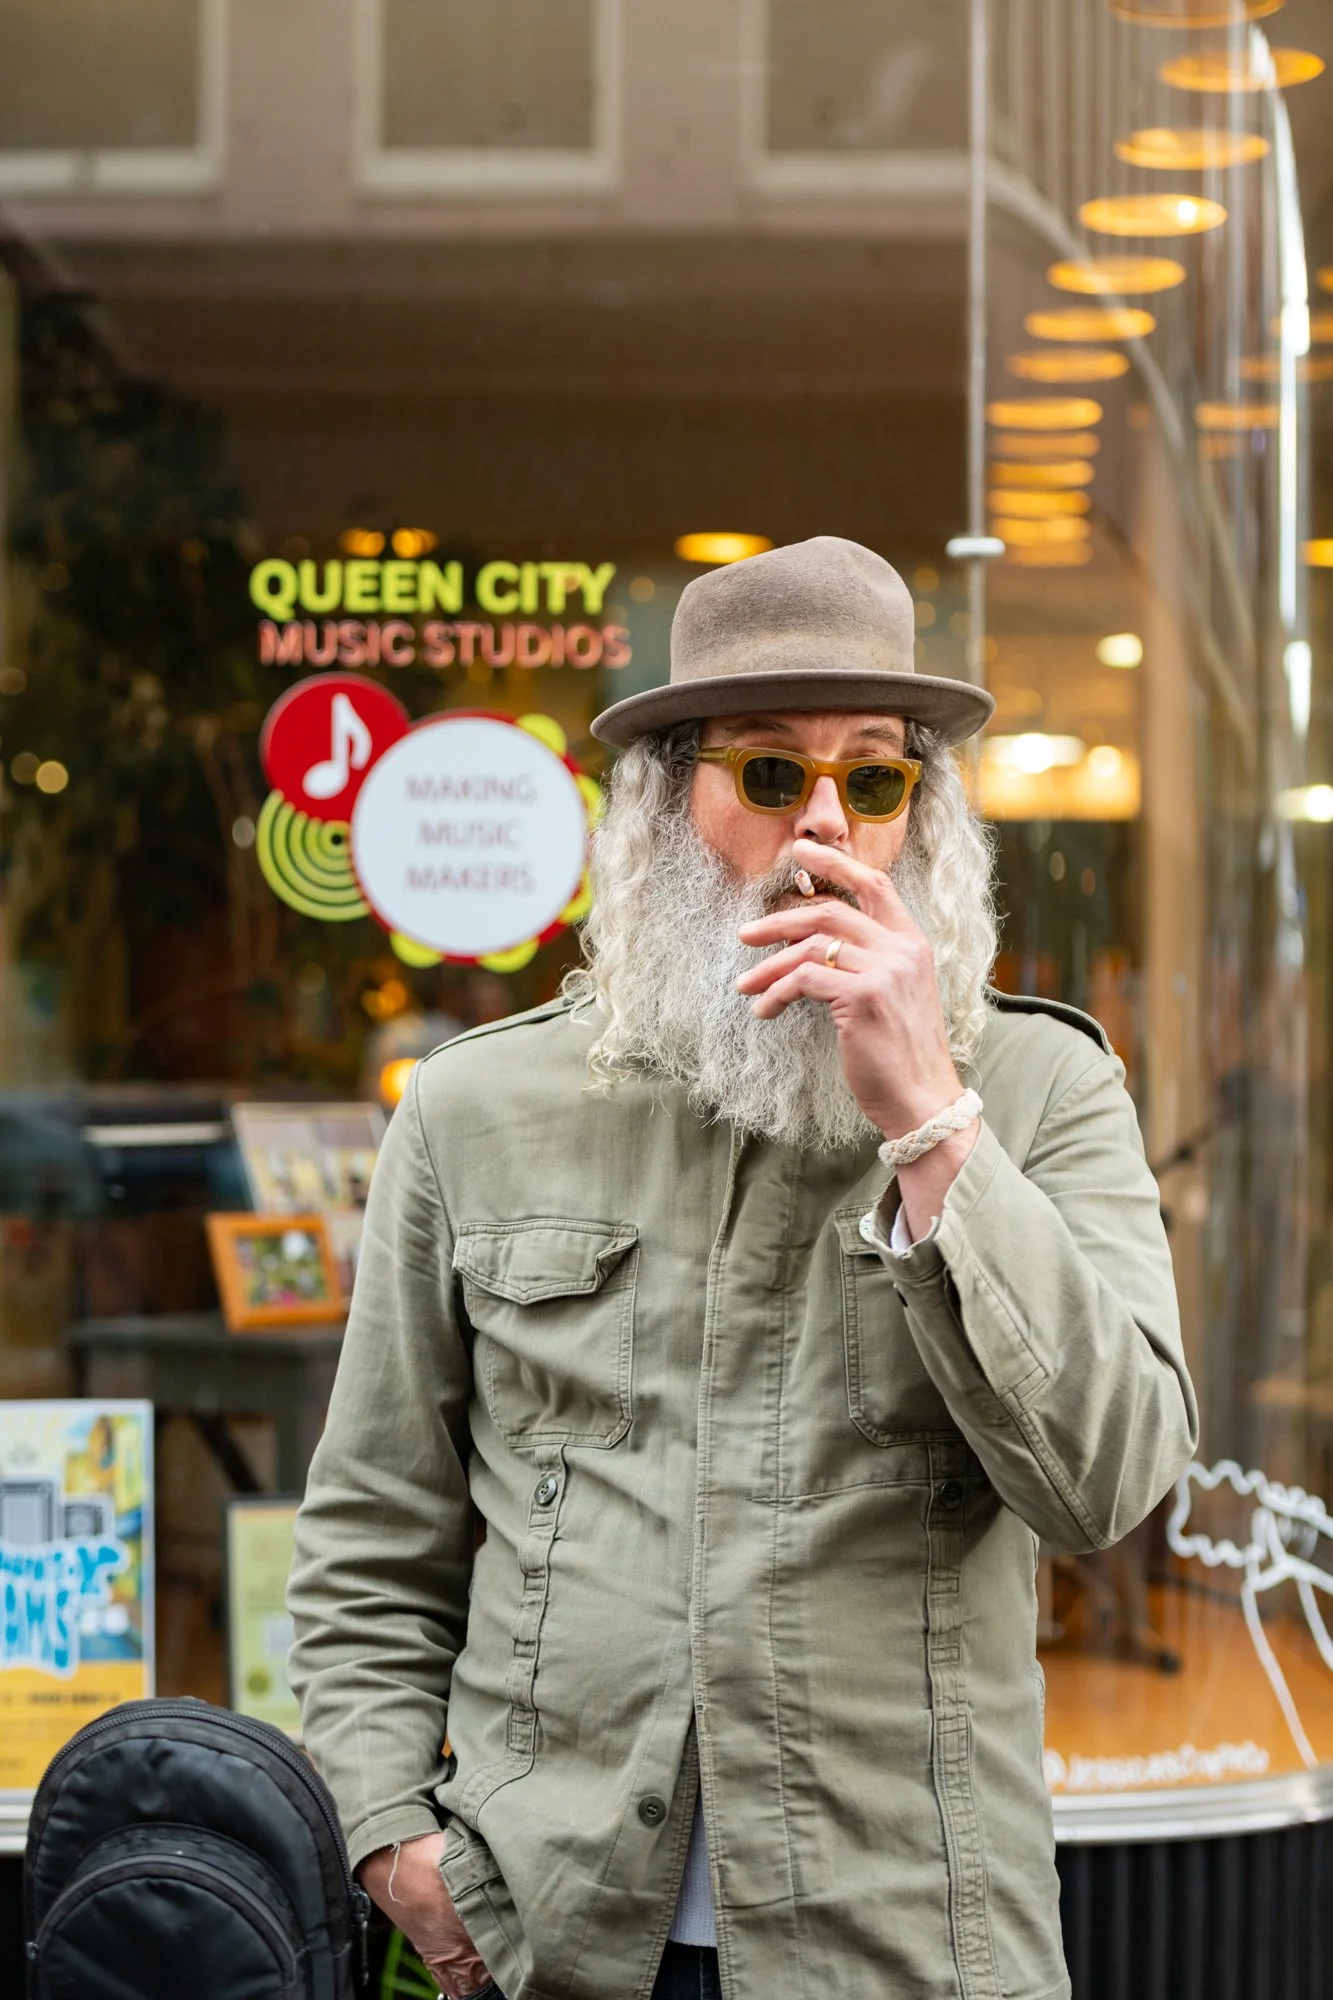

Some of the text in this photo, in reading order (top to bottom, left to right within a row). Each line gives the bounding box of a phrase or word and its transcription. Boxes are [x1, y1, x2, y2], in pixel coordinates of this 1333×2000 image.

[250, 559, 616, 621] QUEEN CITY
[258, 619, 632, 669] MUSIC STUDIOS
[403, 774, 538, 805] MAKING
[417, 818, 523, 850] MUSIC
[404, 864, 538, 897] MAKERS
